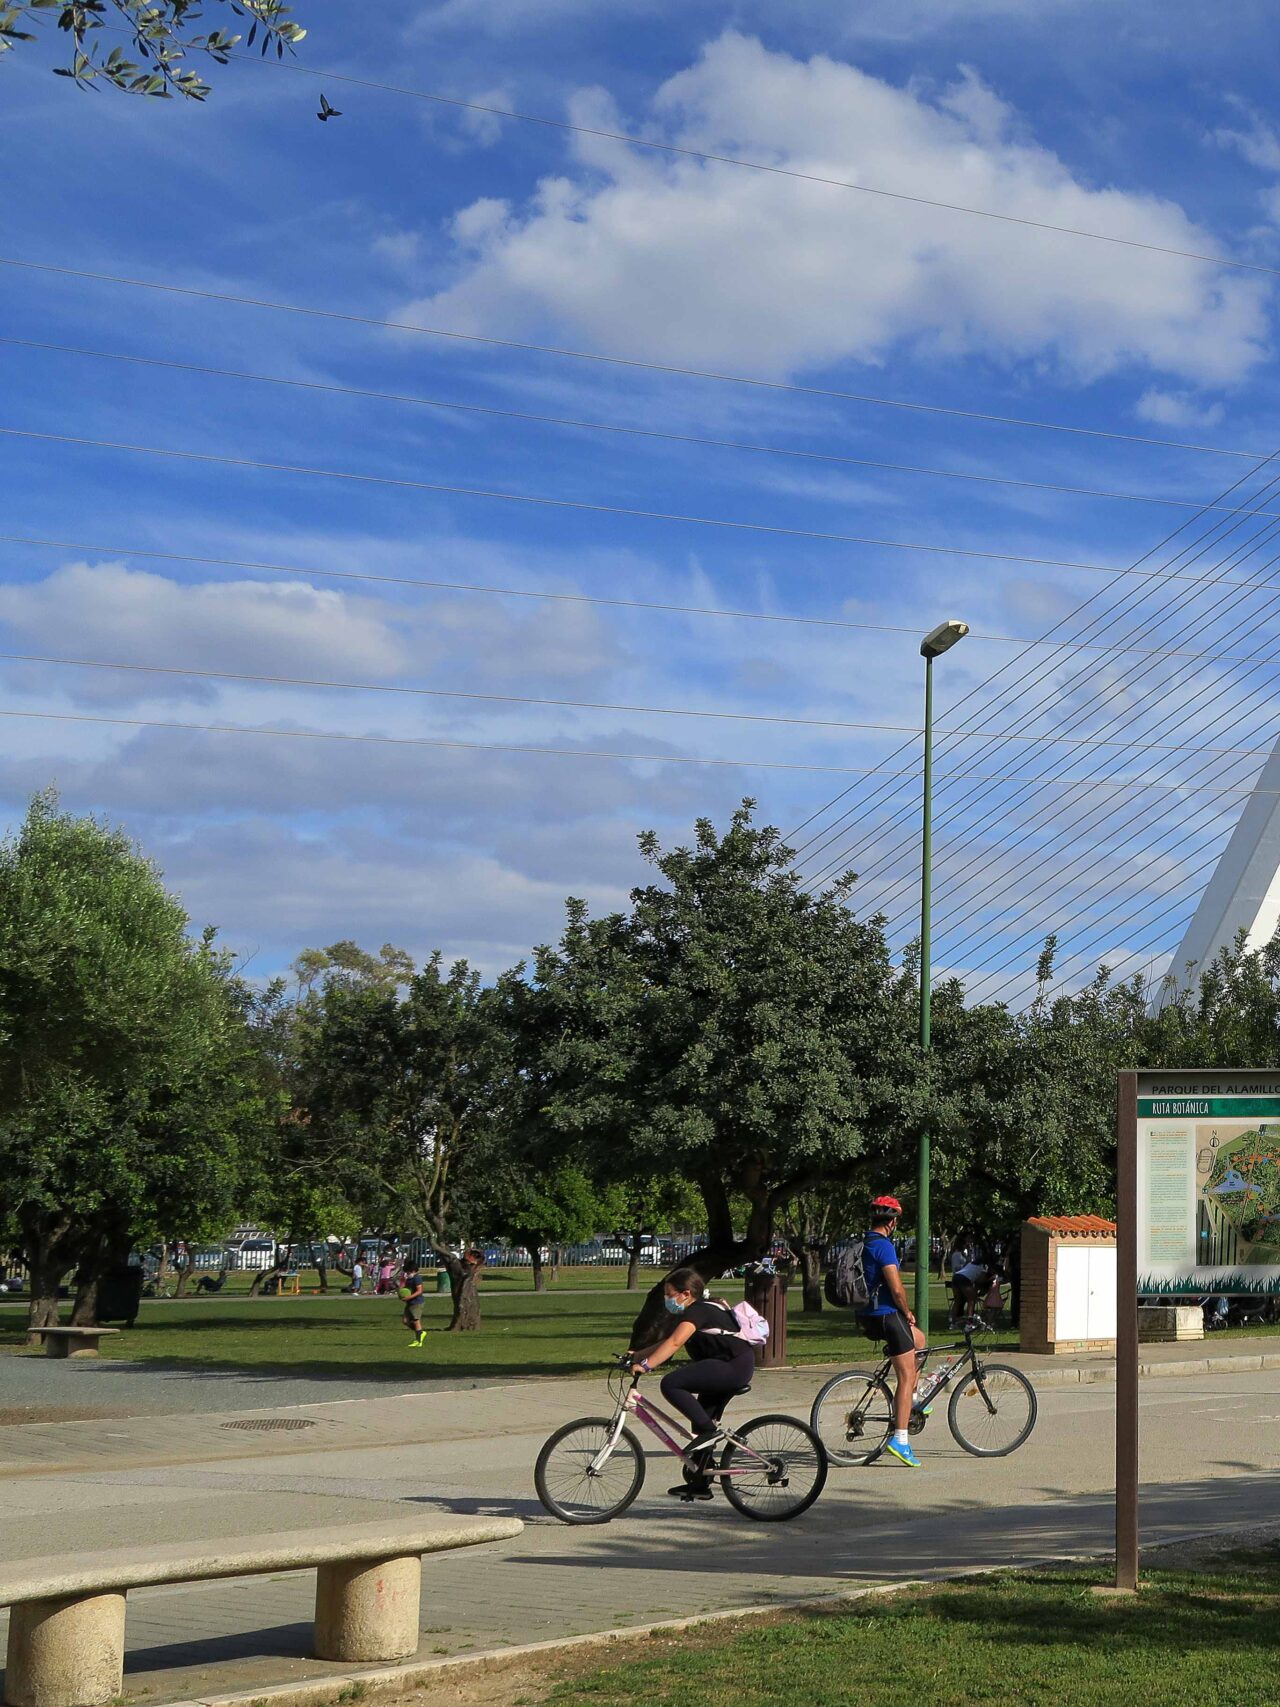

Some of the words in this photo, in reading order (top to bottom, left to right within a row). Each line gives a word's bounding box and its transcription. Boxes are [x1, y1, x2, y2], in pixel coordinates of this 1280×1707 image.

[1152, 1085, 1198, 1095] PARQUE
[1202, 1085, 1223, 1094] DEL
[1152, 1102, 1170, 1114] RUTA
[1172, 1100, 1209, 1114] BOTÁNICA
